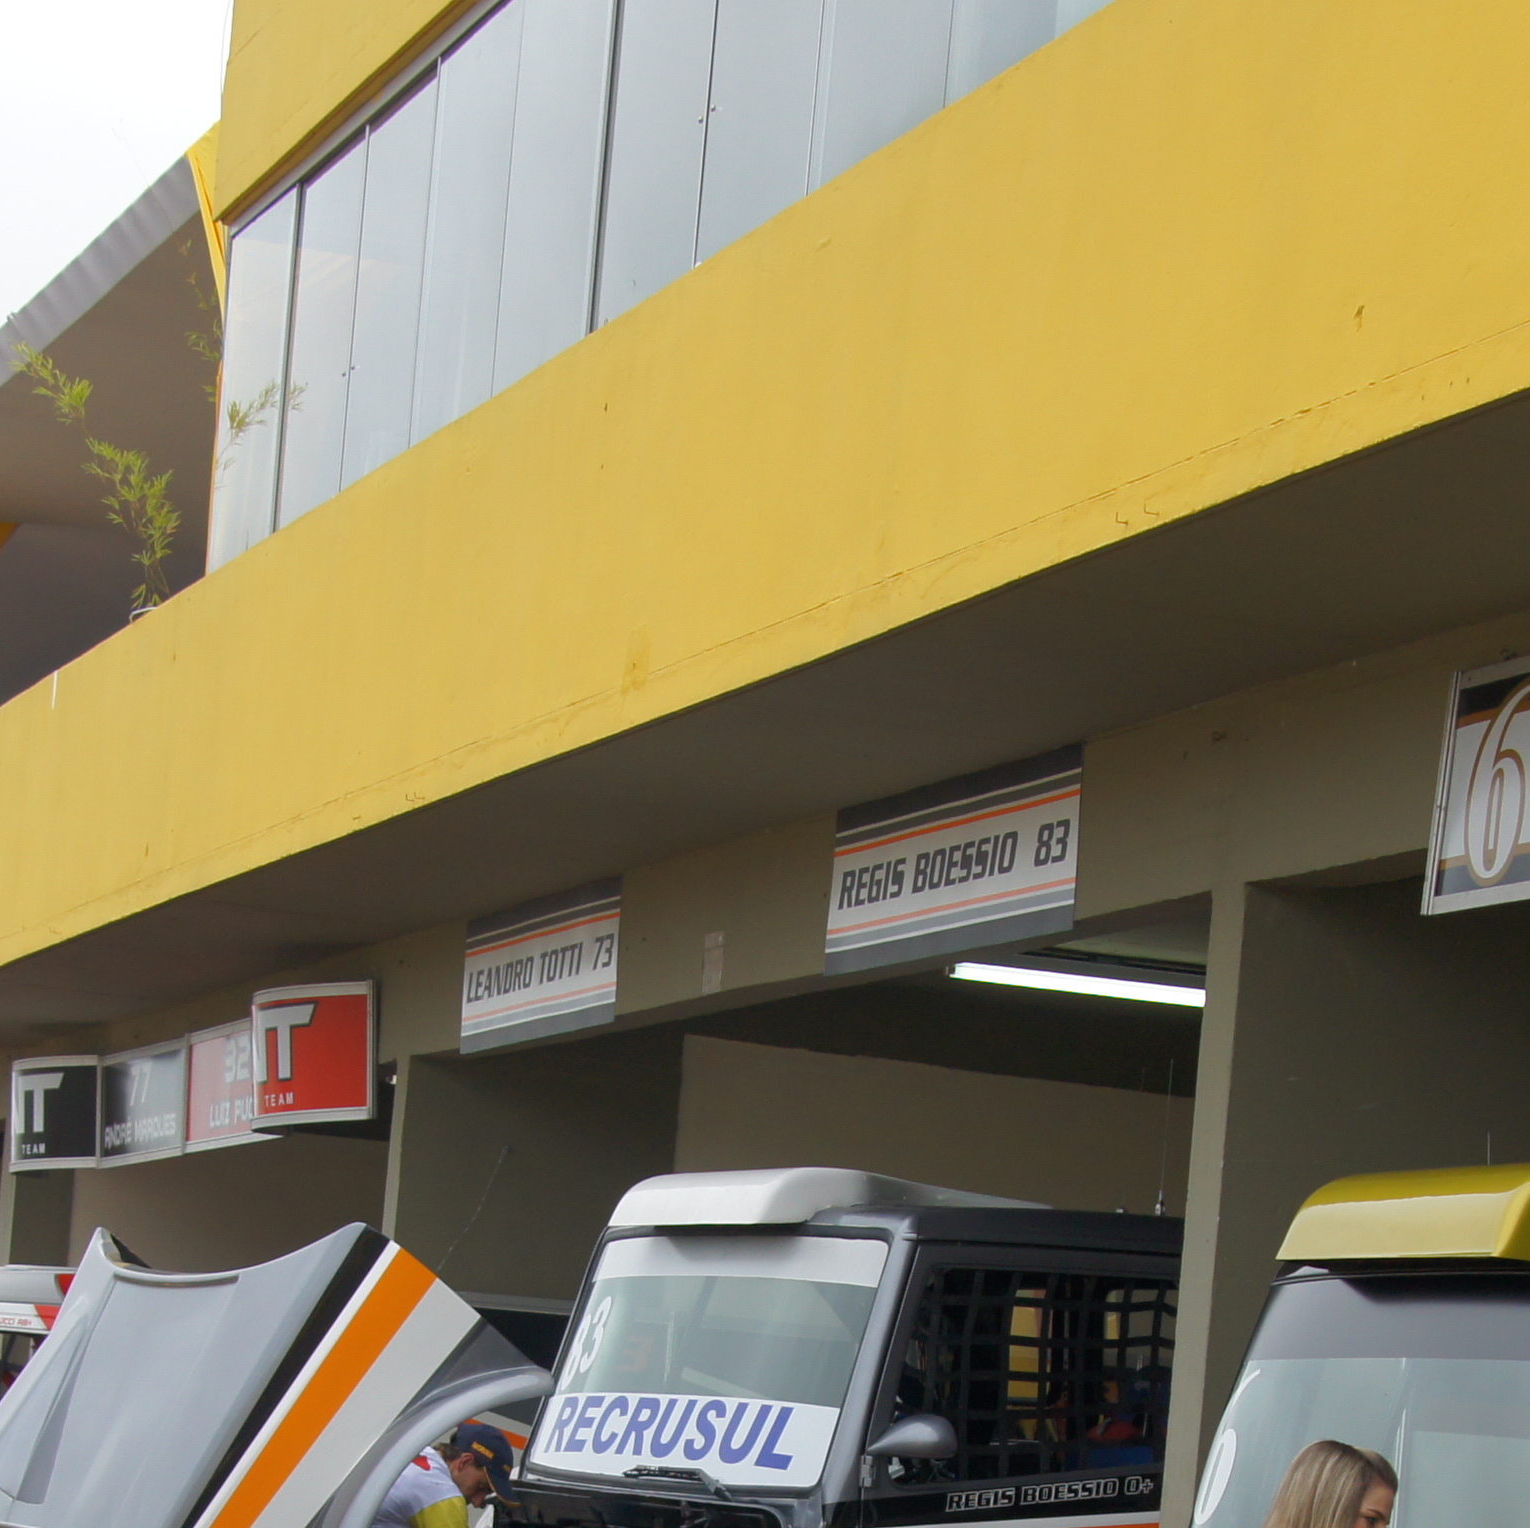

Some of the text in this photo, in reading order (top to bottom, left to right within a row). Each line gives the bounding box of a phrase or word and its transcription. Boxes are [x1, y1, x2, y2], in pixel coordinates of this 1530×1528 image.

[837, 819, 1072, 910] REGIS BOESSIO 83
[467, 933, 616, 1004] LEANDRO TOTTI 73
[209, 1095, 254, 1129] LUIZ PUC
[265, 1092, 295, 1107] TEAM
[134, 1113, 176, 1142] MARQUES
[22, 1143, 46, 1154] TEAM
[543, 1394, 796, 1472] RECRUSUL
[944, 1485, 1015, 1512] REGIS
[1019, 1479, 1119, 1507] BOESSIO
